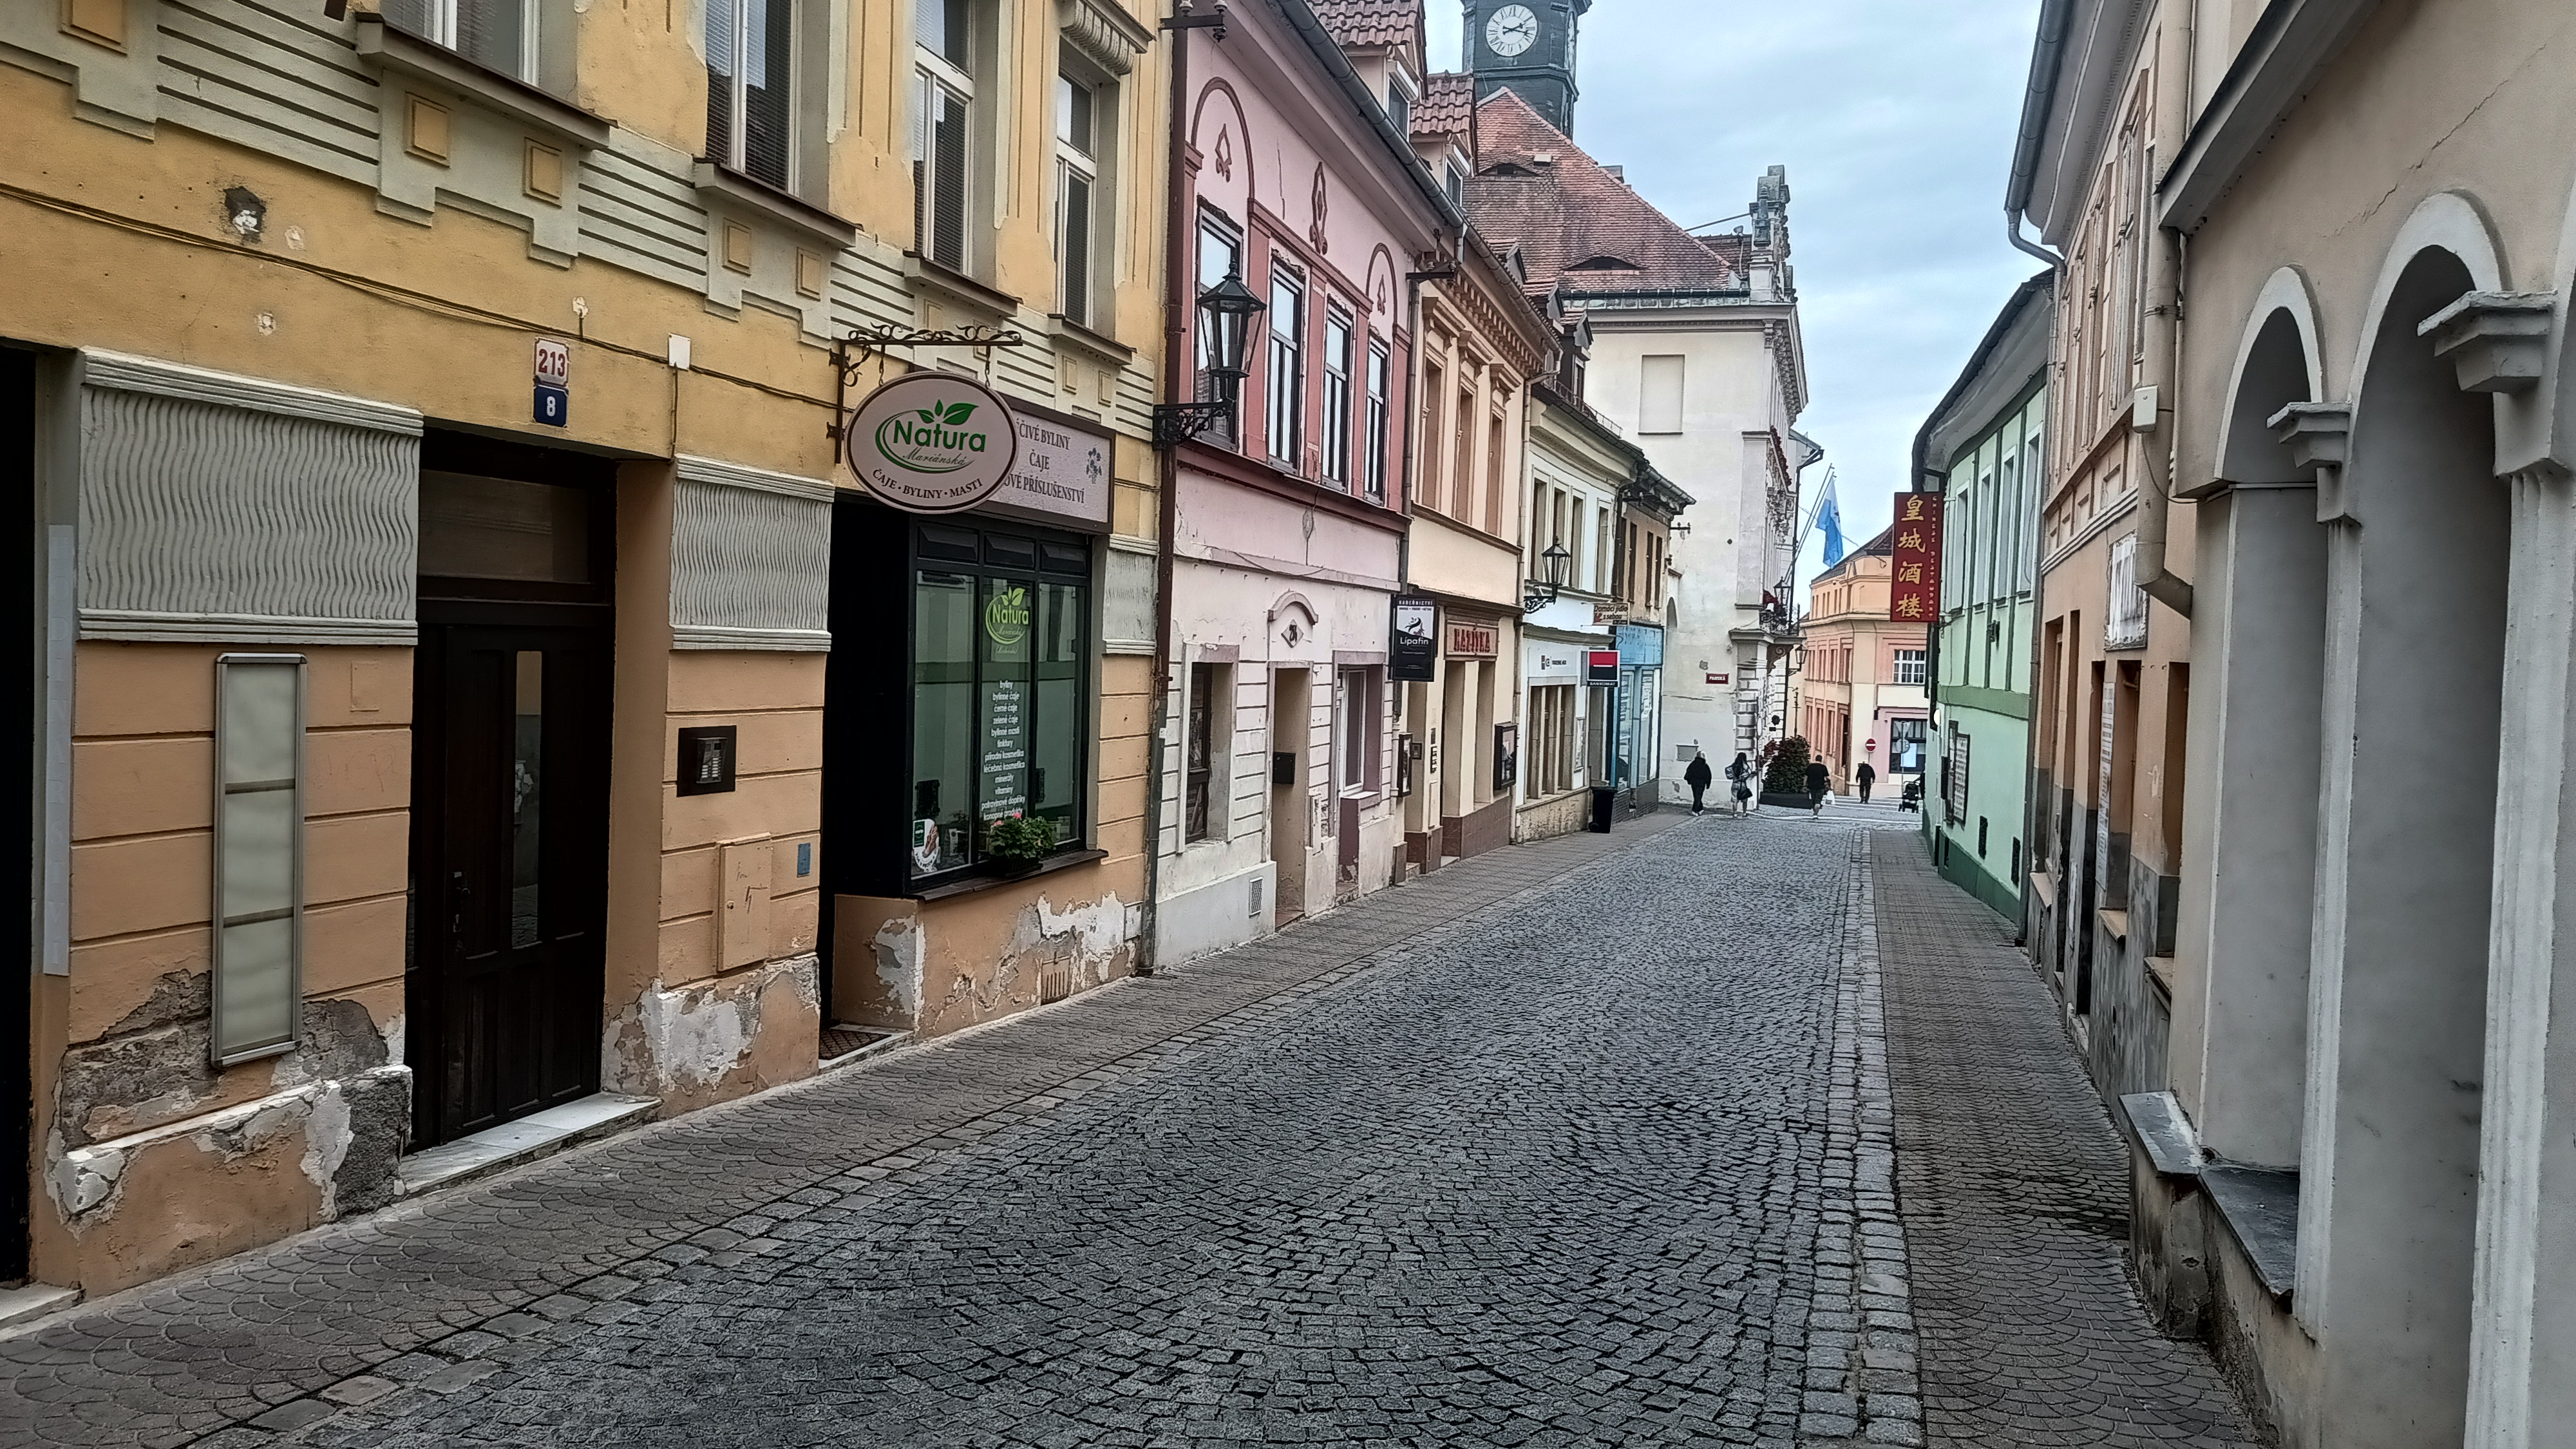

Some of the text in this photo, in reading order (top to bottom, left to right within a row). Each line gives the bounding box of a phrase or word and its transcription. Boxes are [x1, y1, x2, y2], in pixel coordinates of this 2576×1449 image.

[538, 348, 565, 377] 213
[546, 396, 556, 417] 8
[893, 420, 986, 452] Natura
[1041, 429, 1071, 450] BYLINY
[902, 447, 971, 466] Mariánská
[1029, 449, 1050, 472] ČAJE
[873, 468, 983, 498] ČAJE BYLINY MASTI
[1005, 472, 1085, 503] OVÉ PŘÍSLUŠENSTVÍ
[1896, 495, 1926, 619] 皇城酒楼
[992, 604, 1029, 625] Natura
[1400, 637, 1428, 646] Lípafin
